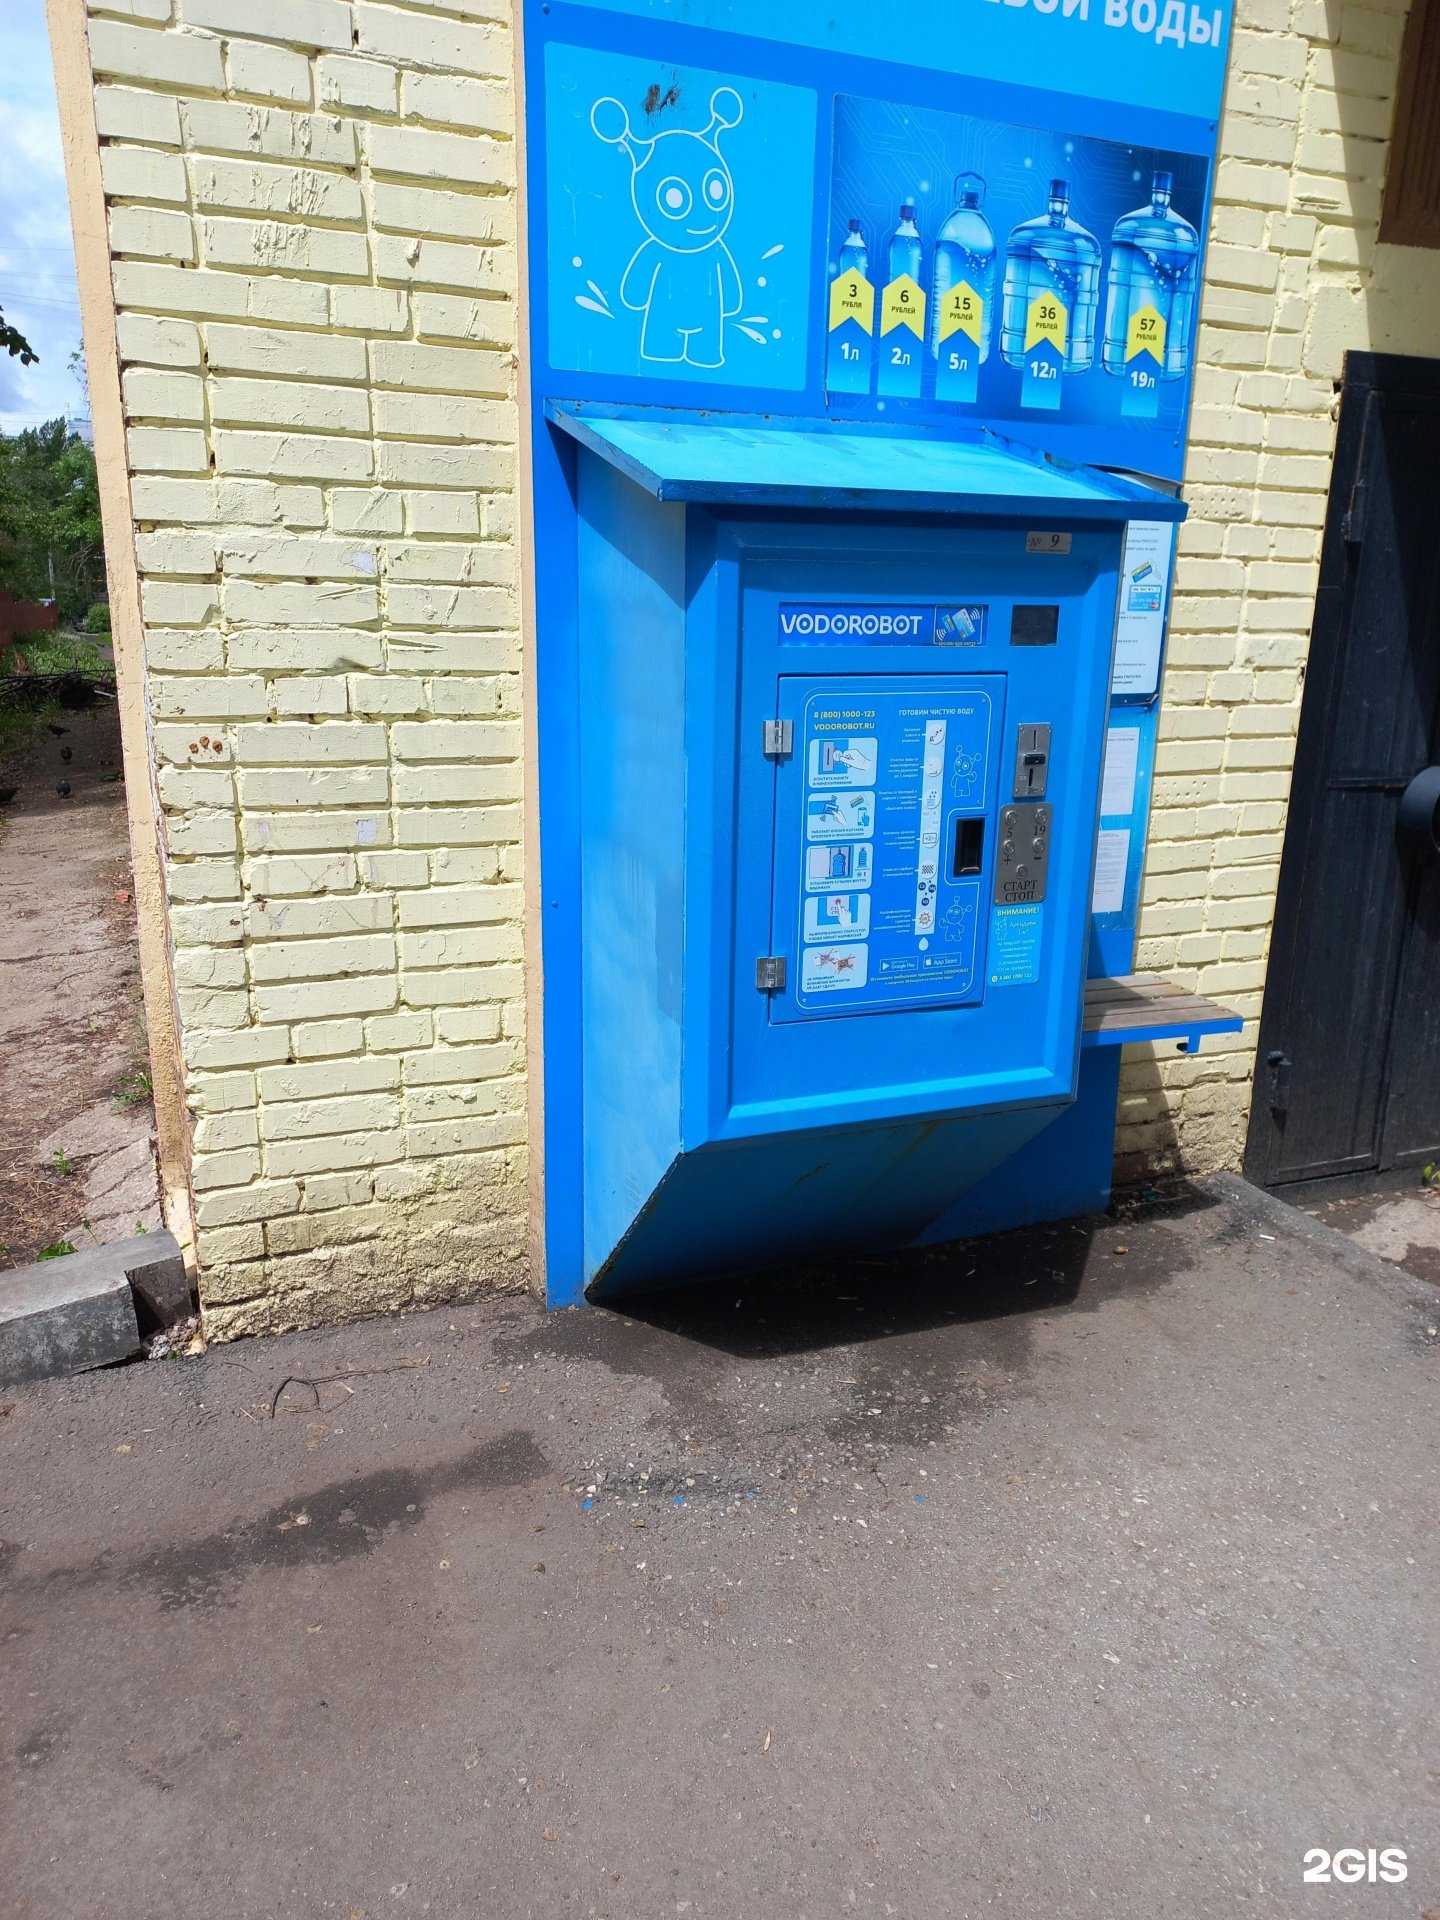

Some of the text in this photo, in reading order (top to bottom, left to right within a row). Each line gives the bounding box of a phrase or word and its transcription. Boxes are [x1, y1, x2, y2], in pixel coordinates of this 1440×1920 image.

[1104, 0, 1223, 48] ВОДЫ
[849, 284, 858, 298] 3
[900, 289, 910, 303] 6
[841, 300, 863, 308] РУБЛЯ
[954, 296, 971, 310] 15
[891, 305, 916, 314] РУБЛЕЙ
[1039, 306, 1056, 320] 36
[949, 312, 973, 321] РУБЛЕЙ
[1035, 322, 1058, 330] РУБЛЕЙ
[1140, 318, 1156, 331] 57
[1050, 534, 1060, 548] 9
[780, 613, 923, 635] VODOROBOT
[899, 707, 974, 717] ГОТОВИМ ЧИСТУЮ ВОДУ
[814, 722, 875, 731] VODOROBOT.RU
[1003, 880, 1038, 892] СТАРТ
[1005, 891, 1034, 902] СТОП
